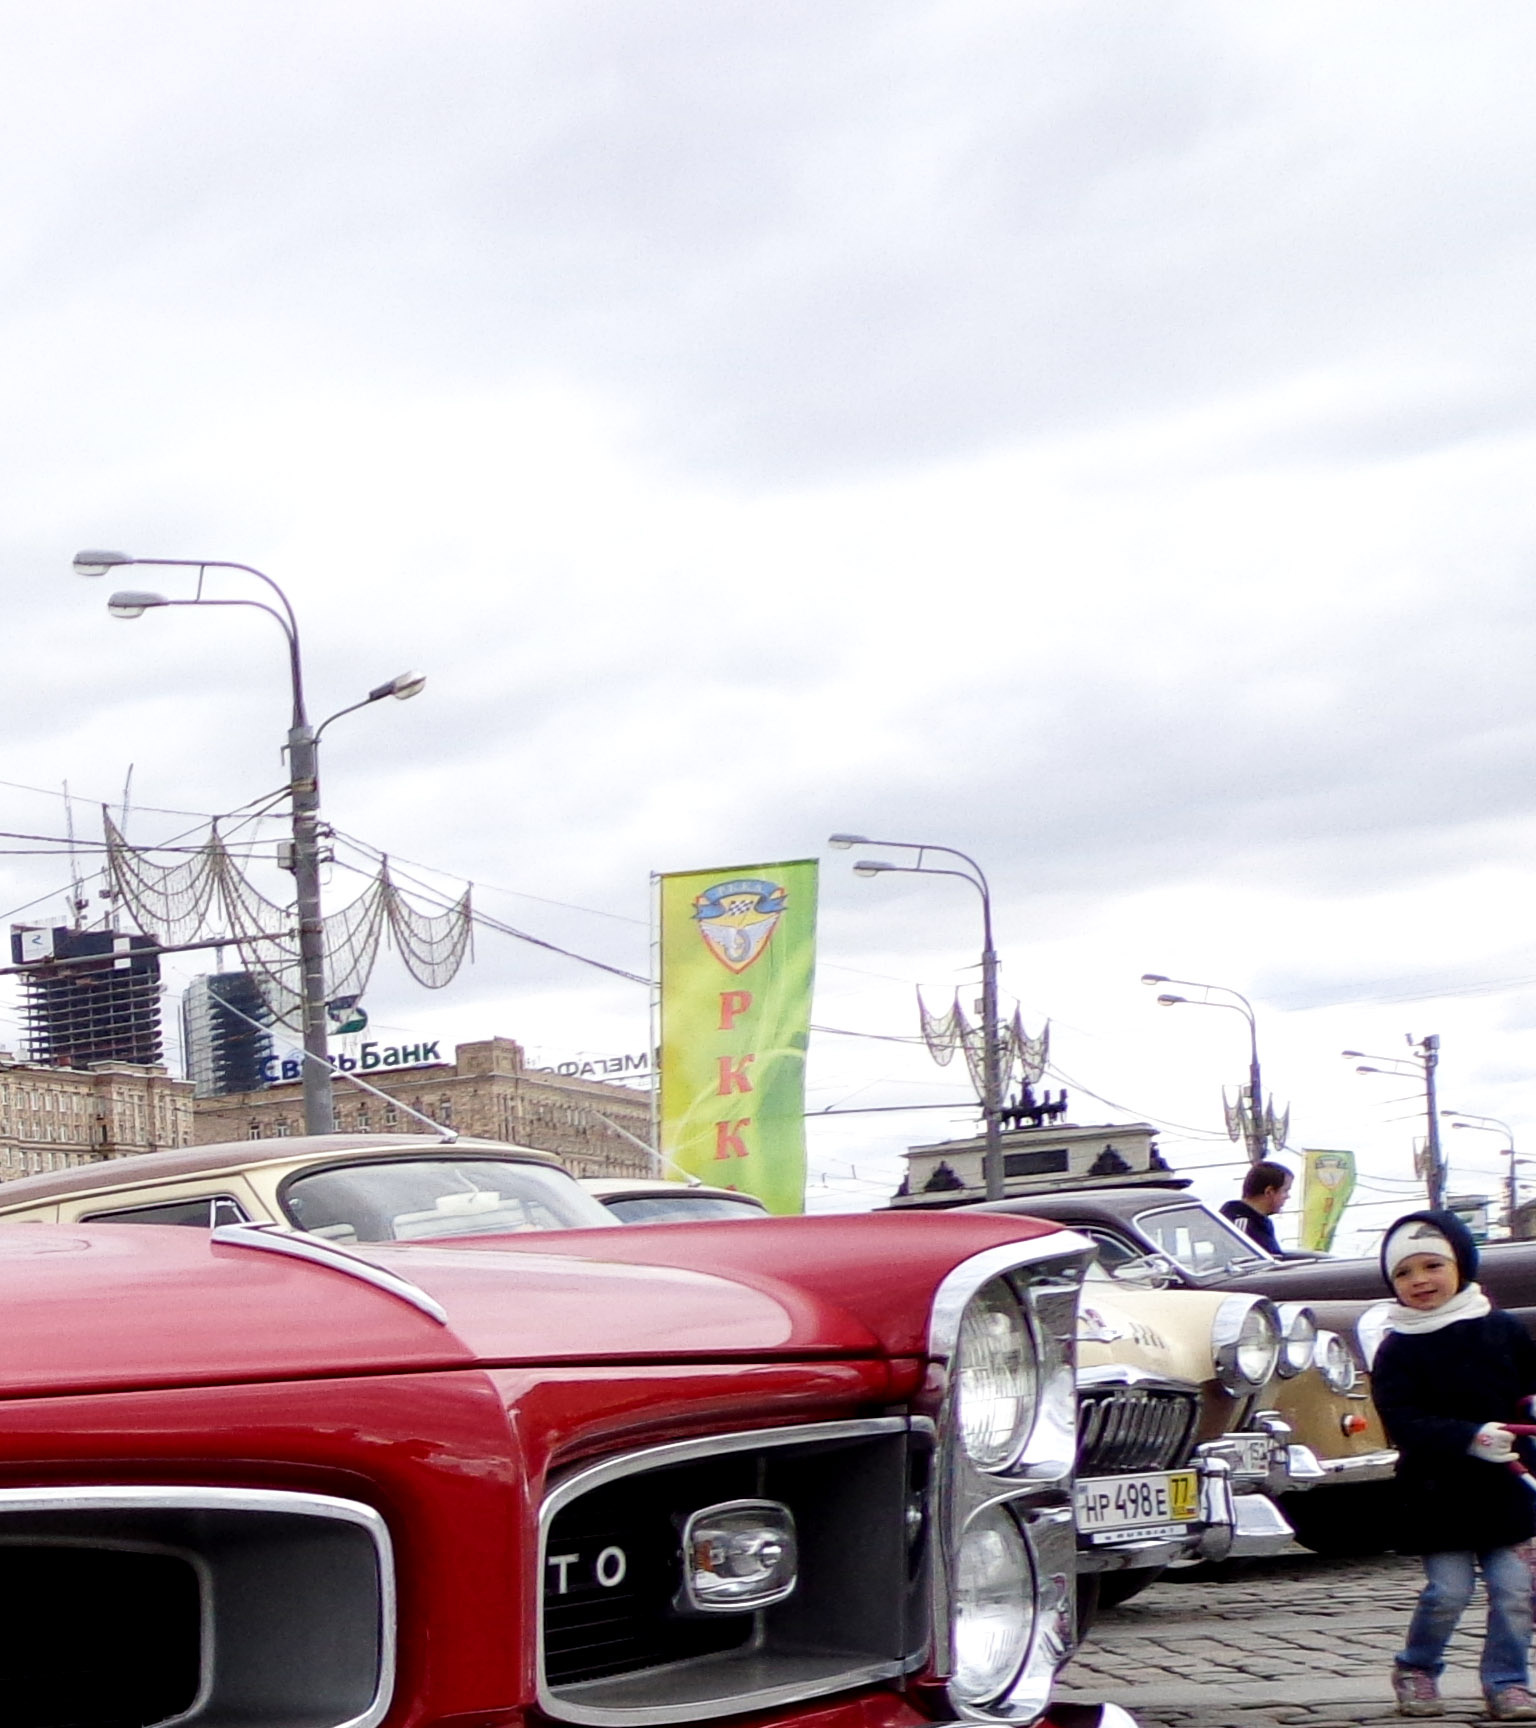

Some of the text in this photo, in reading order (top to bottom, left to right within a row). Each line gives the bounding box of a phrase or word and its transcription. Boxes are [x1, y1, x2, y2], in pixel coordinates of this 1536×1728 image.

[260, 1040, 440, 1082] СвзьБанк
[715, 989, 755, 1191] РКК
[1171, 1477, 1188, 1505] 77
